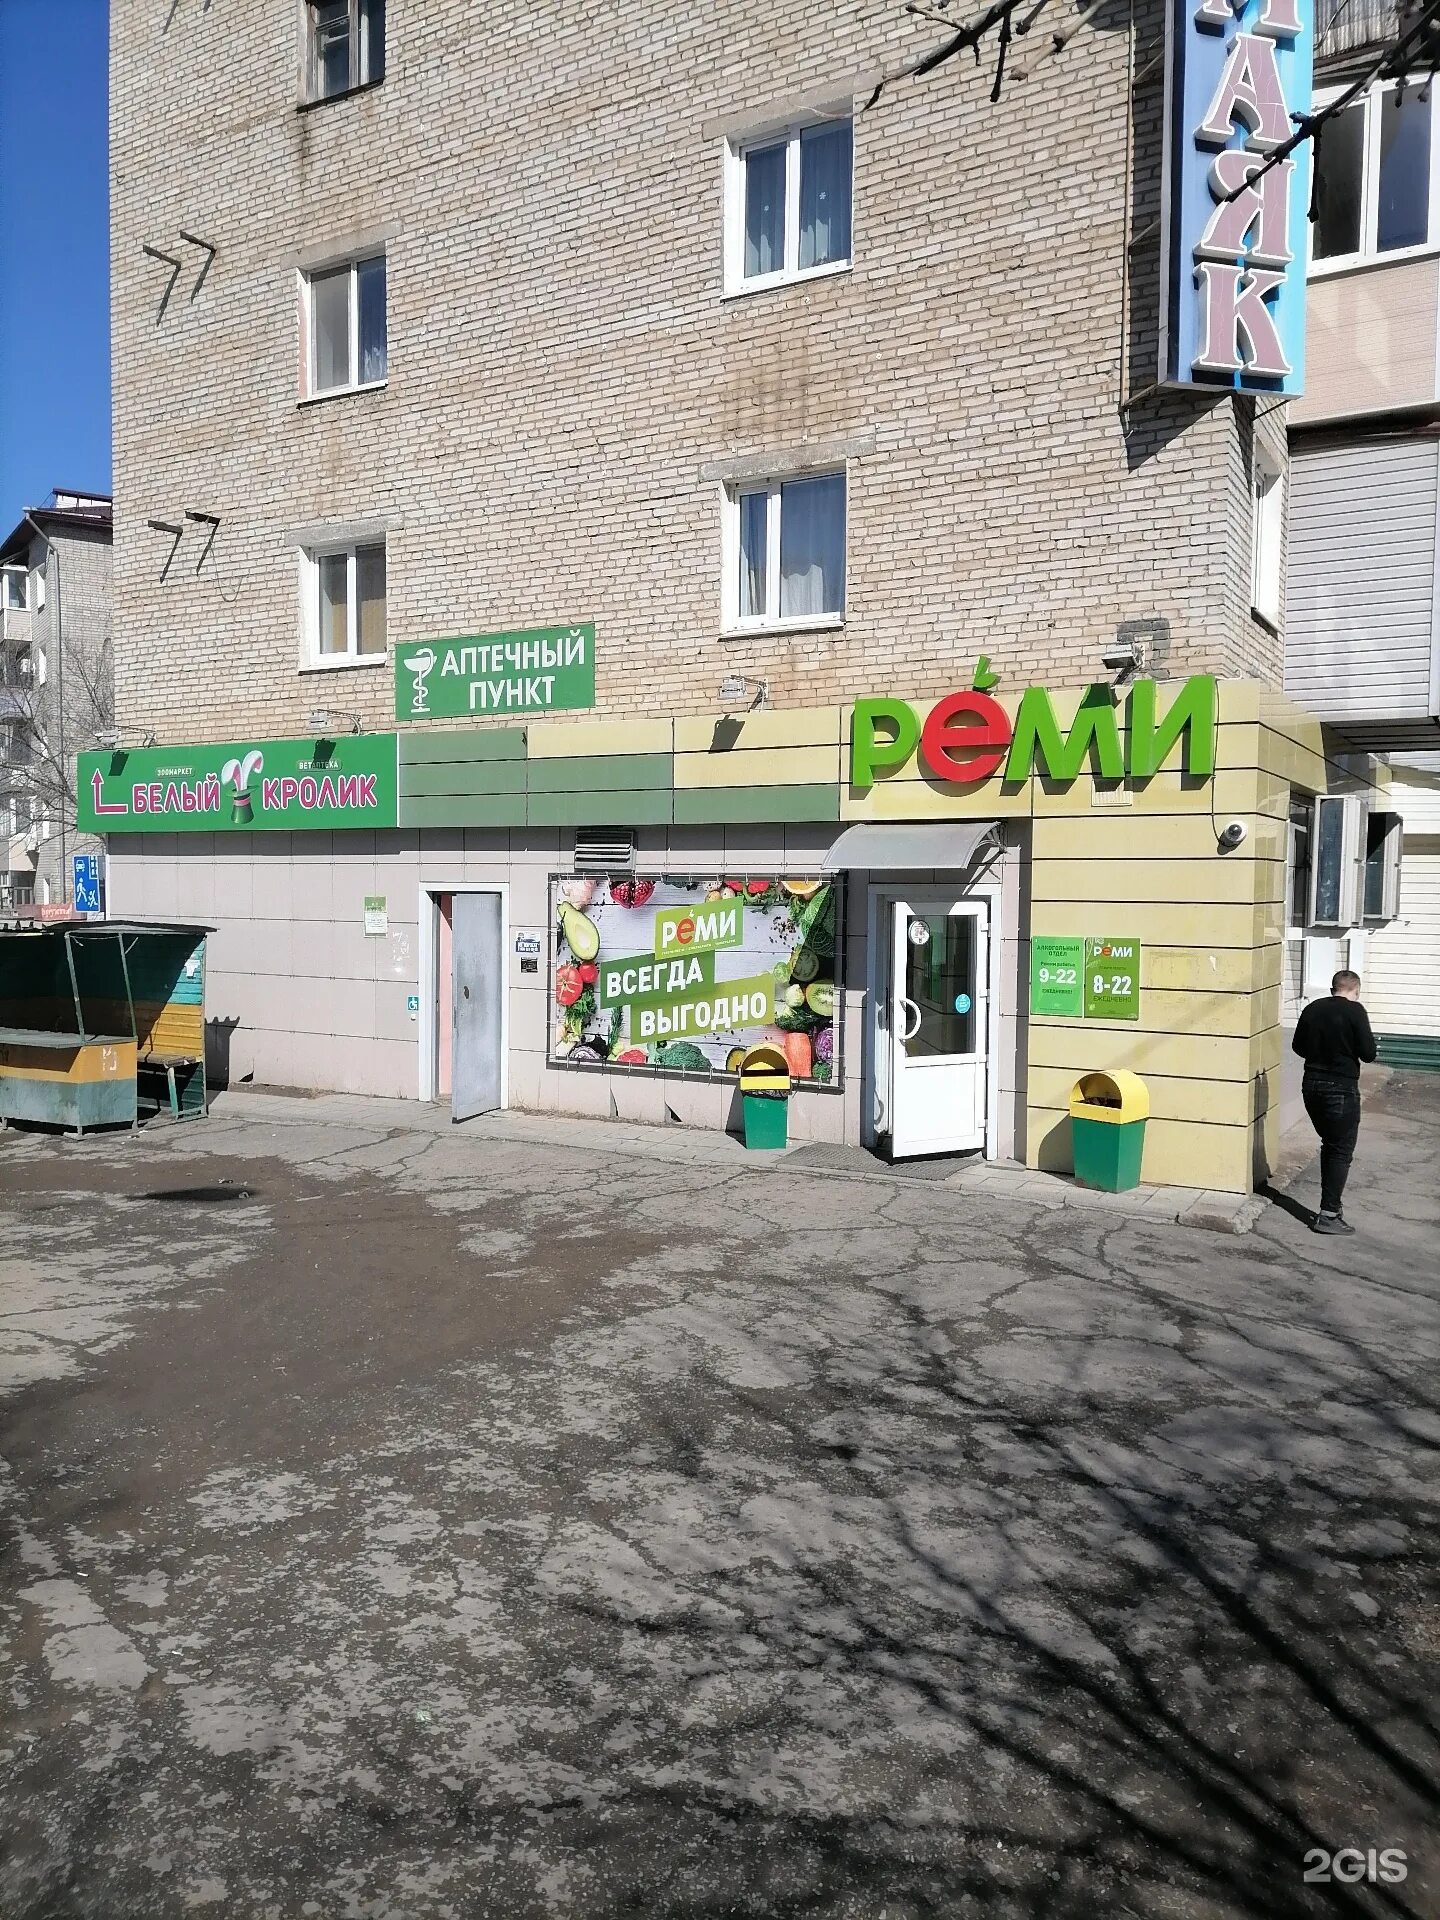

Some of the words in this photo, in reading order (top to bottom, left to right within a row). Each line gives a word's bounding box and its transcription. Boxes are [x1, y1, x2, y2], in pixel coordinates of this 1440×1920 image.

[1199, 0, 1303, 375] АЯК
[440, 628, 586, 677] АПТЕЧНЫЙ
[469, 675, 556, 710] ПУНКТ
[157, 766, 193, 777] ЗООМАРКЕТ
[298, 760, 339, 770] ВЕТАПТЕКА
[132, 773, 221, 814] БЕЛЫЙ
[261, 773, 378, 811] КРОЛИК
[606, 957, 704, 999] ВСЕГДА
[1038, 967, 1077, 985] 9-22
[1093, 974, 1132, 996] 8-22
[640, 992, 768, 1037] ВЫГОДНО
